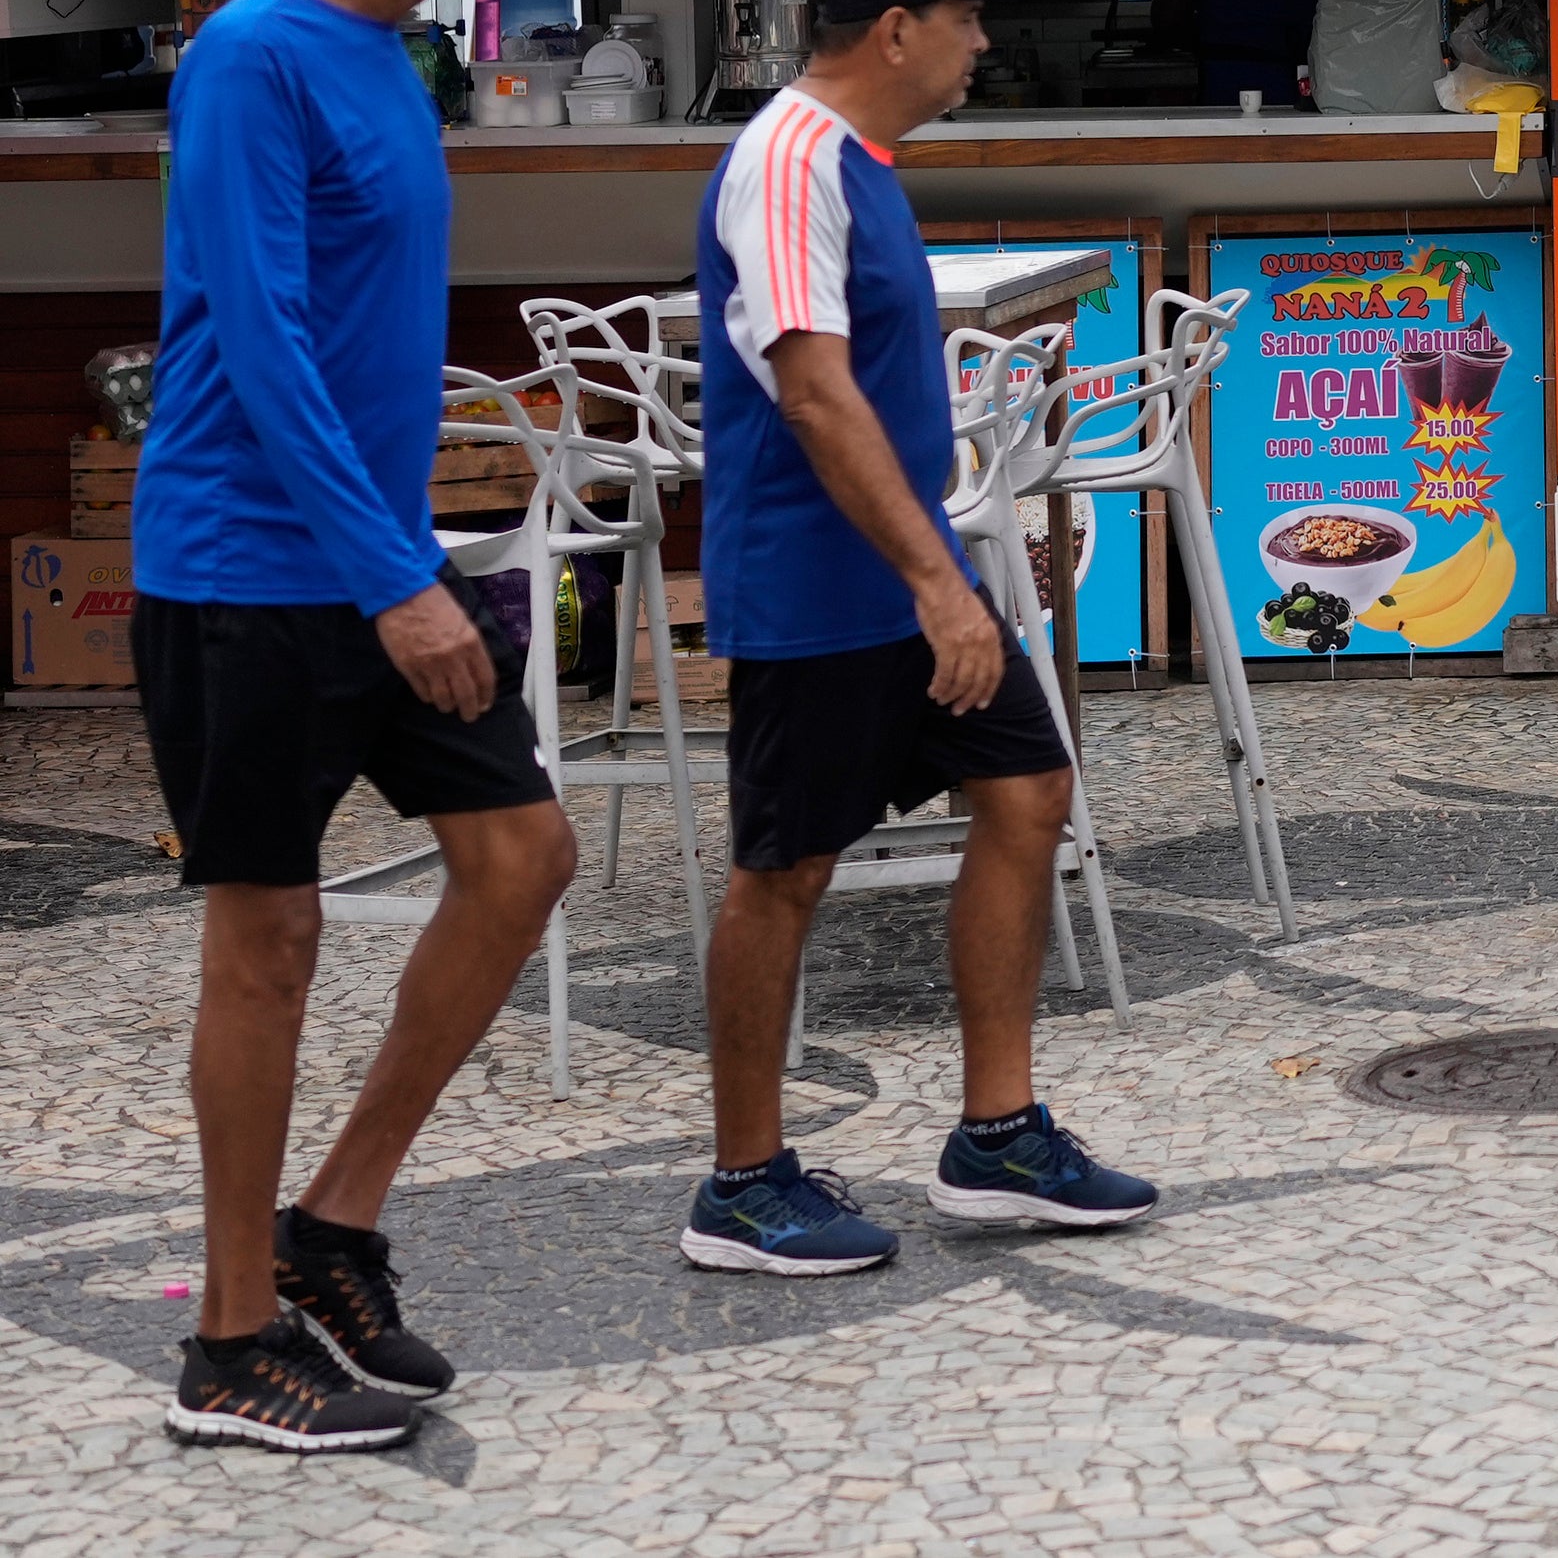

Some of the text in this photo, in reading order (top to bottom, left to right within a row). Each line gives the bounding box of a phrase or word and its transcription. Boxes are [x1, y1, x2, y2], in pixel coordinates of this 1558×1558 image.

[1260, 251, 1404, 276] QUIOSQUE
[1273, 284, 1429, 321] NANÁ 2
[1261, 327, 1492, 357] Sabor 100% Natural
[1274, 359, 1401, 430] AÇAÍ
[1426, 419, 1474, 439] 15,00
[1266, 439, 1312, 458] COPO
[1266, 482, 1323, 501] TIGELA
[1425, 481, 1478, 500] 25,00
[961, 1114, 1028, 1137] adidas
